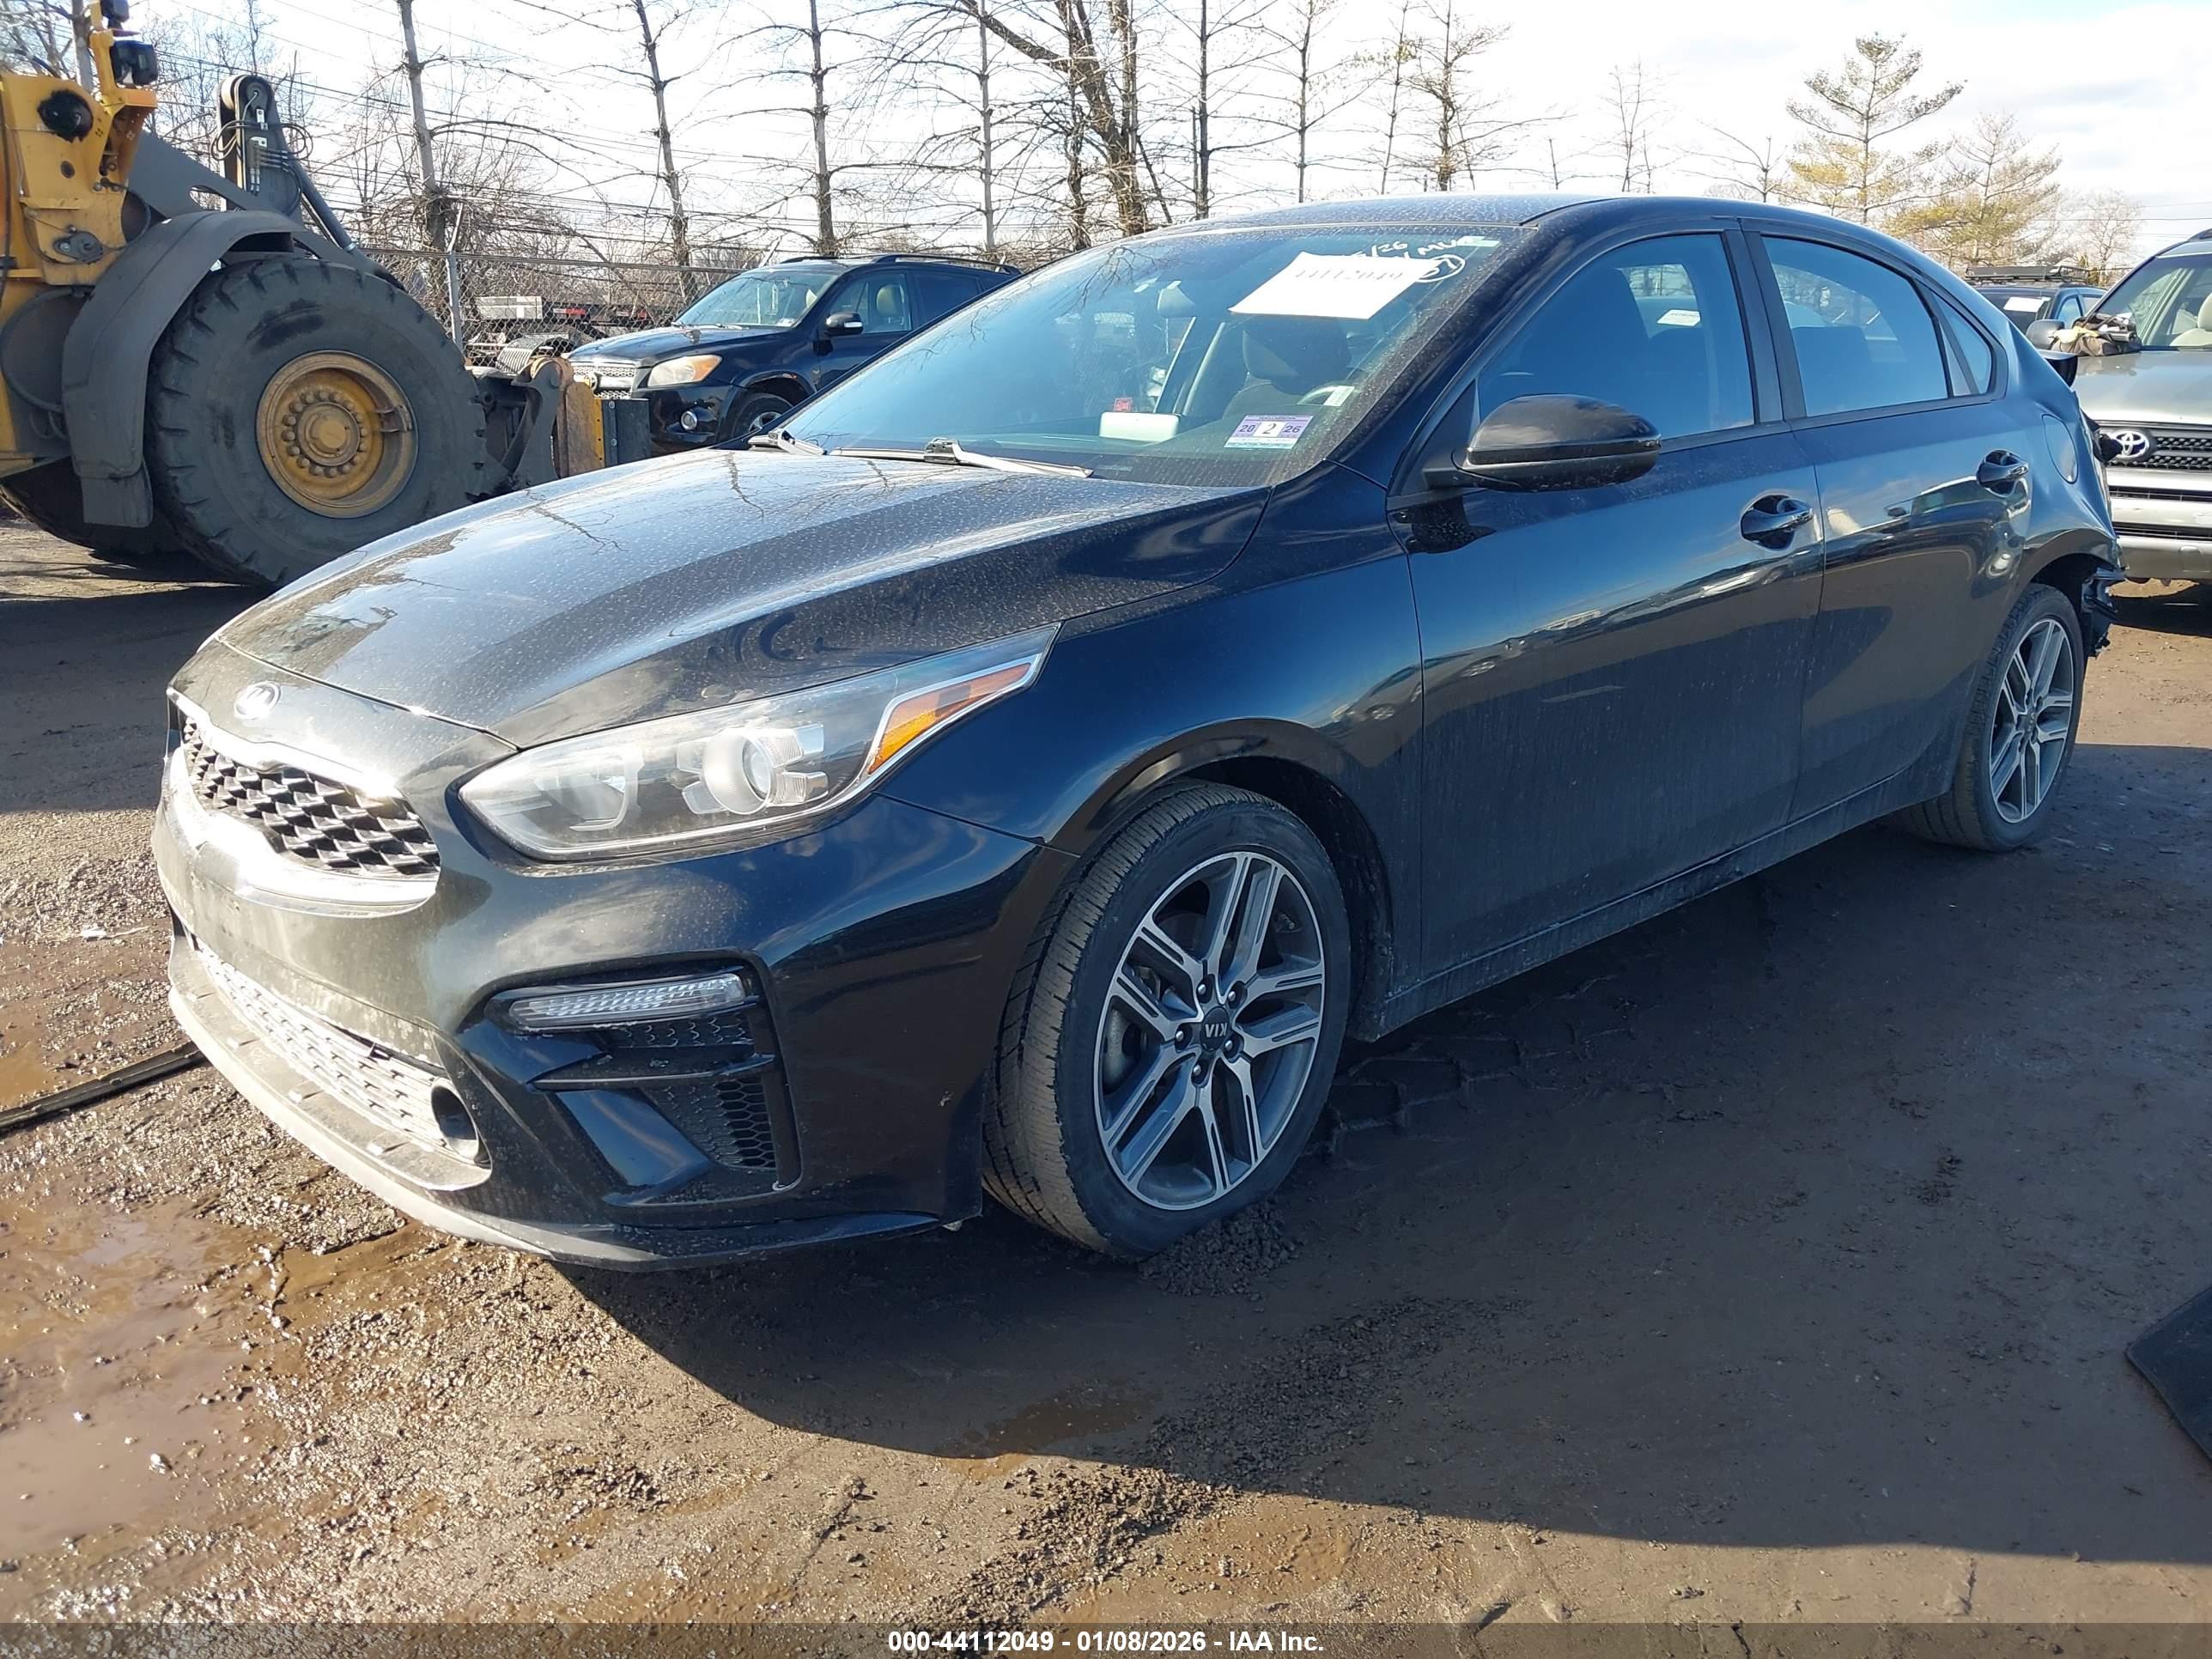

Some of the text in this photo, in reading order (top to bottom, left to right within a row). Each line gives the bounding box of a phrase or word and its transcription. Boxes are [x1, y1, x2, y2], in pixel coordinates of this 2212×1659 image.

[1239, 422, 1301, 434] 20 2 26
[1205, 1023, 1228, 1038] KIA
